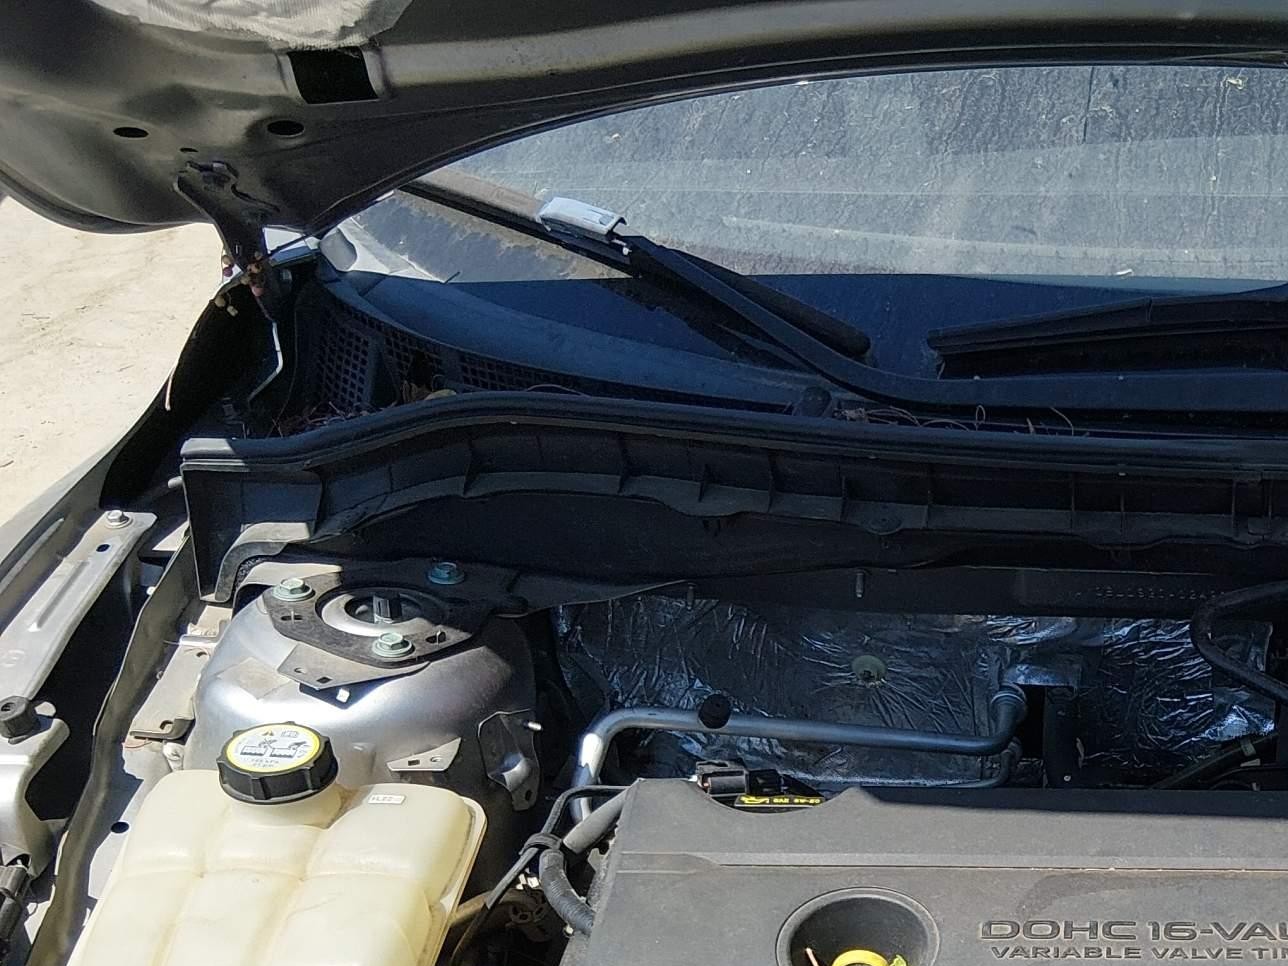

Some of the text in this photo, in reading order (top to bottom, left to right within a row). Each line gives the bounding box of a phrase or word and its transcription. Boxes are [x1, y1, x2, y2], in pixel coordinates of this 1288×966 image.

[980, 919, 1137, 942] DOHC
[991, 945, 1142, 960] VARIABLE
[1151, 946, 1244, 960] VALVE
